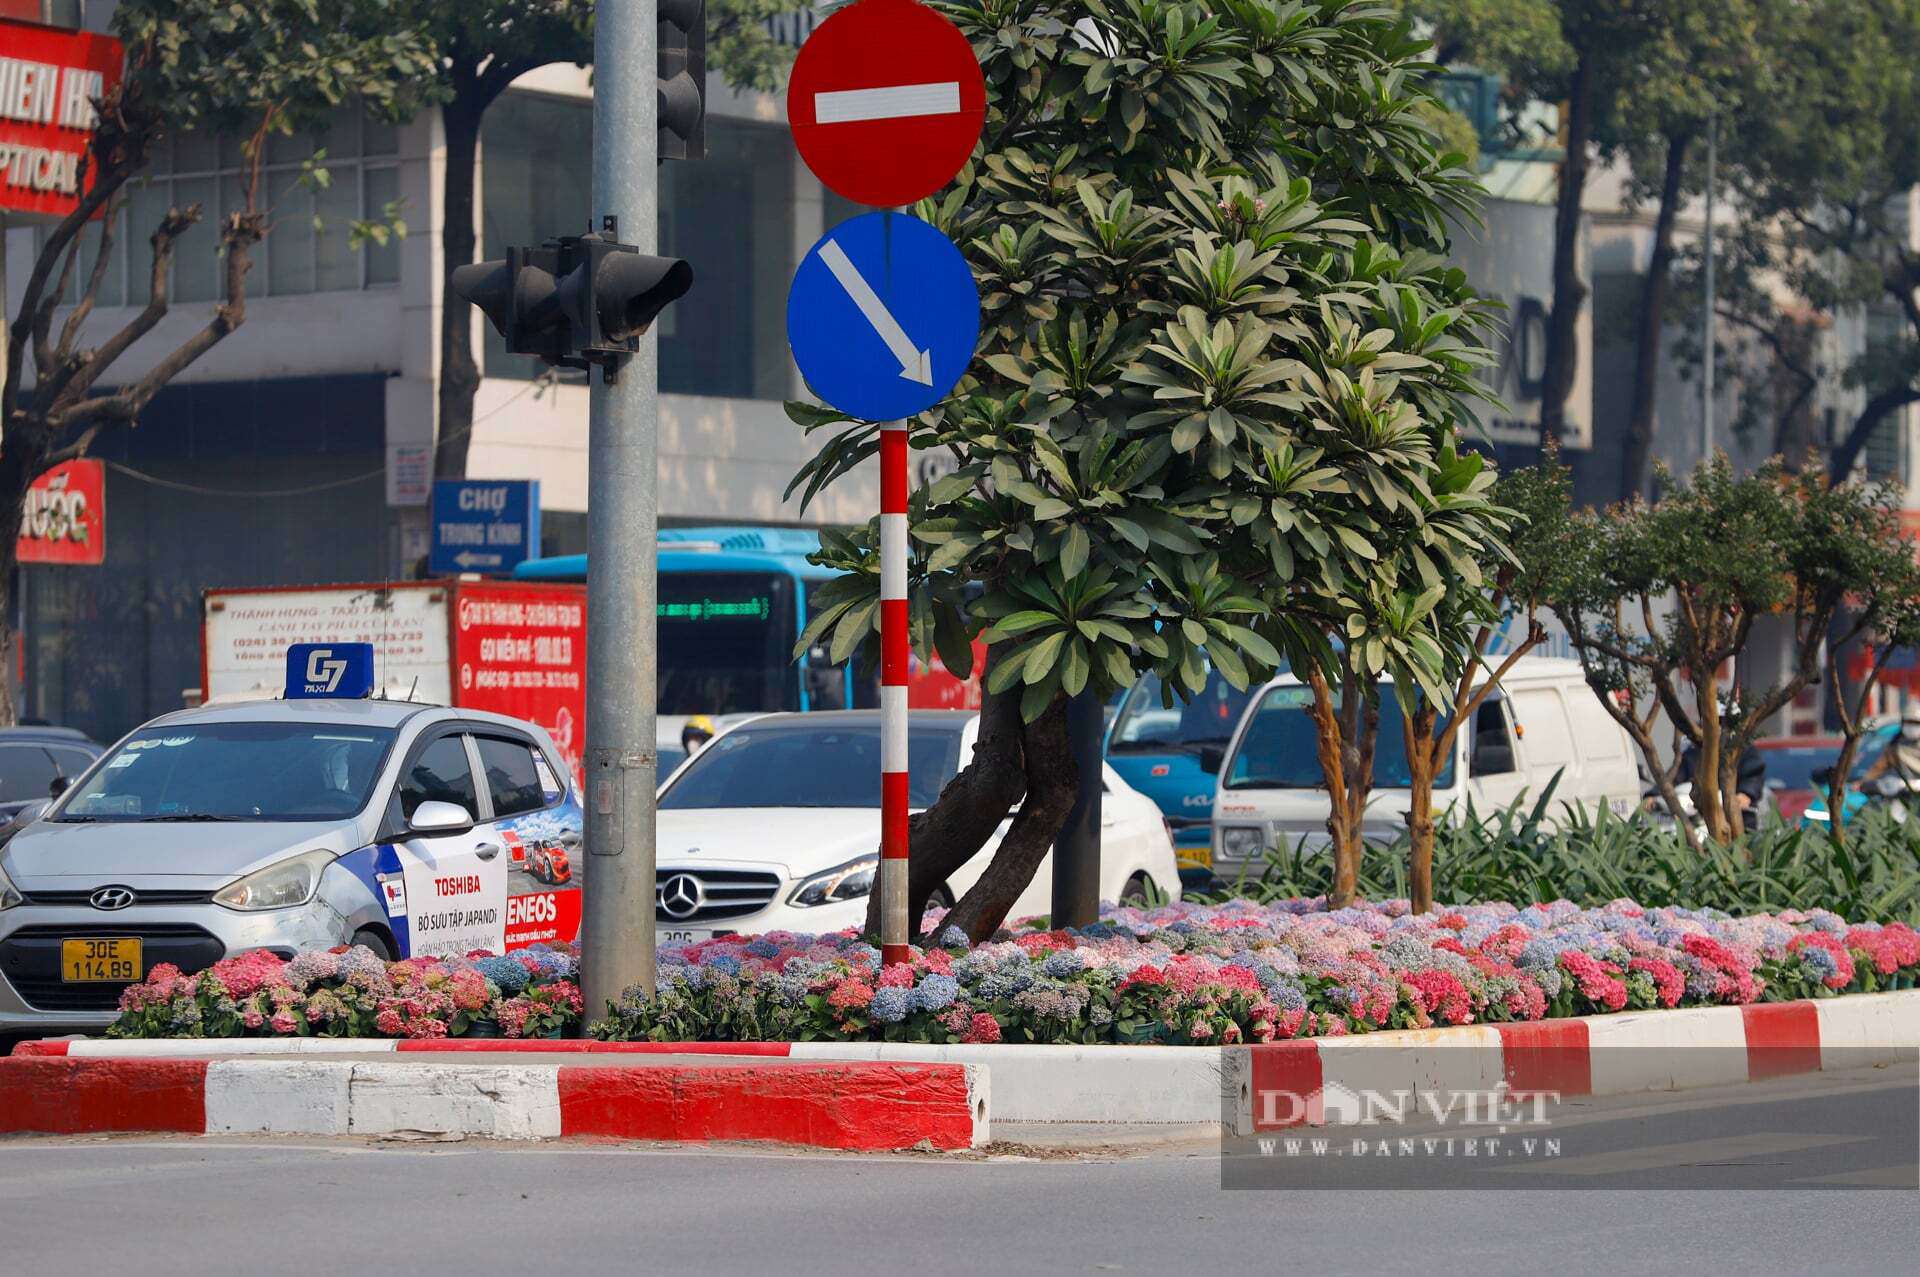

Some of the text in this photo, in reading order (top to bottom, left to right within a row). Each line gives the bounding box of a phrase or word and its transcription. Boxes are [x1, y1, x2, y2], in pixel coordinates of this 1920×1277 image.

[459, 486, 509, 517] CHỢ
[306, 649, 347, 693] G7
[304, 684, 325, 693] TAXI
[435, 875, 481, 897] TOSHIBA
[506, 893, 557, 925] ENEOS
[418, 911, 430, 935] BỘ
[430, 911, 448, 930] SƯU
[448, 908, 464, 932] TẬP
[85, 941, 119, 958] 30E
[73, 960, 133, 979] 114.89
